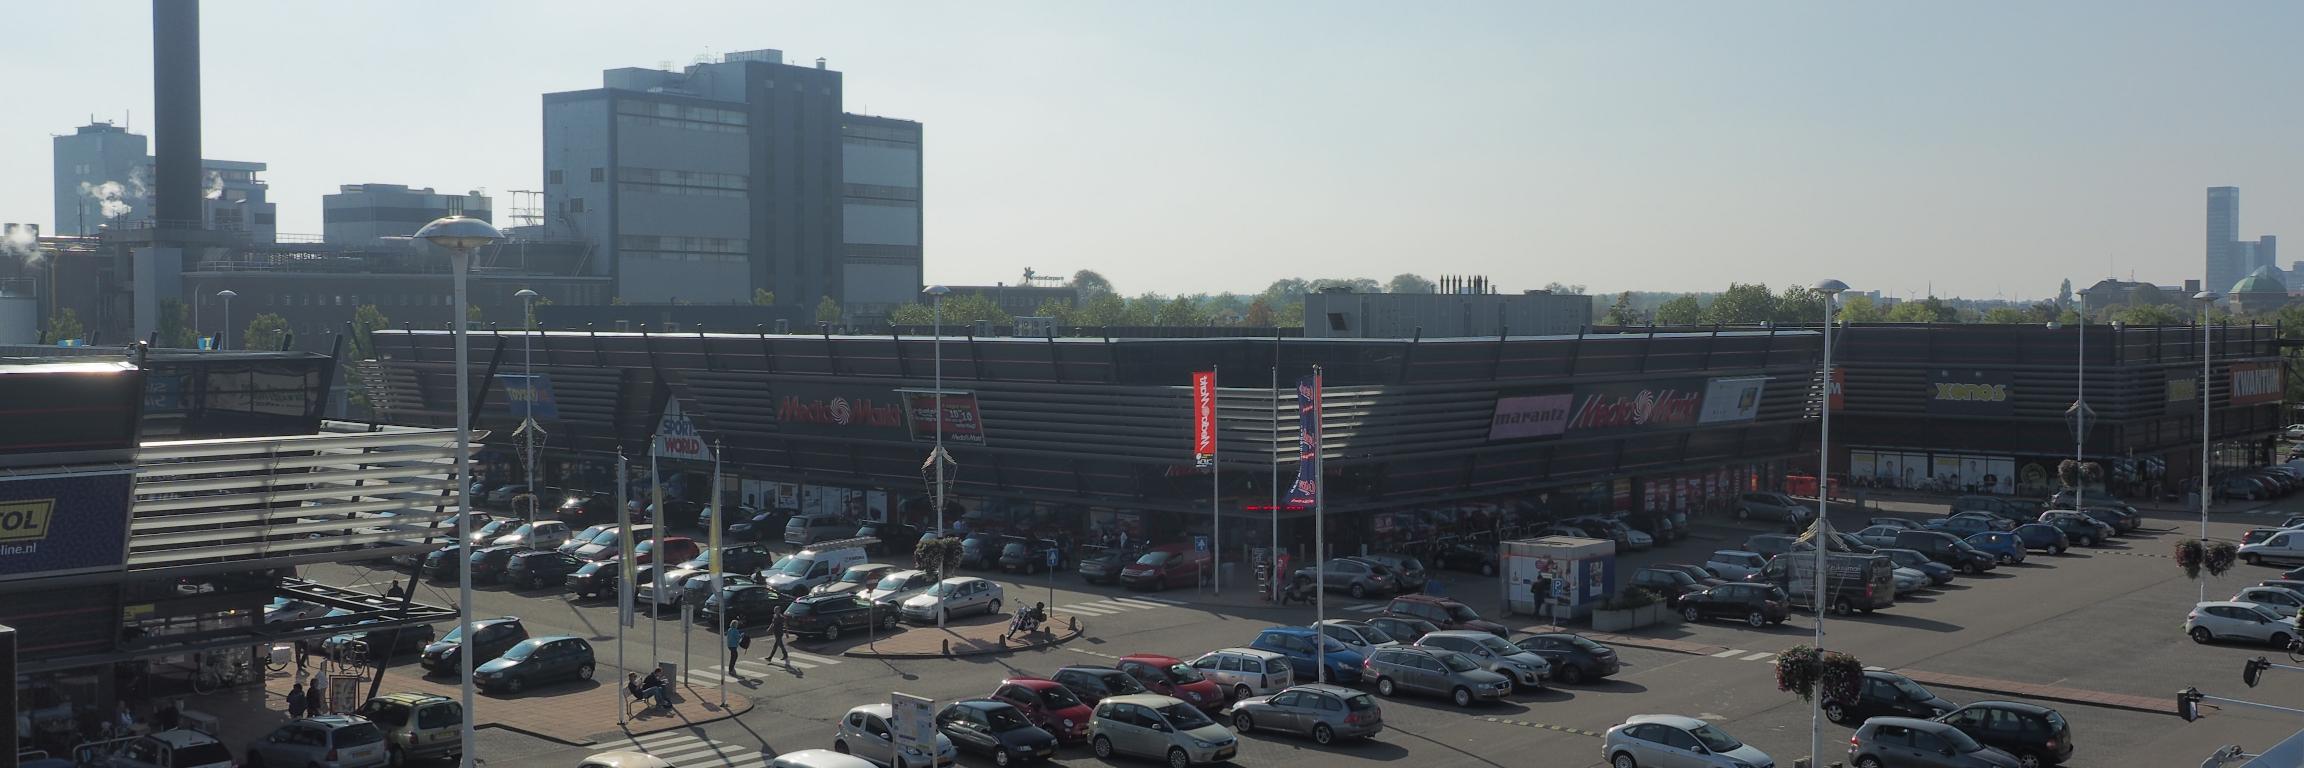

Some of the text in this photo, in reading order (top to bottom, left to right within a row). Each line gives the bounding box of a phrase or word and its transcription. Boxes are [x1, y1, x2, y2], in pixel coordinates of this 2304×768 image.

[2233, 367, 2280, 397] KWANTUM
[1496, 408, 1565, 425] marantz
[664, 419, 692, 437] SPORT
[665, 437, 700, 454] WORLD
[0, 510, 38, 530] OL
